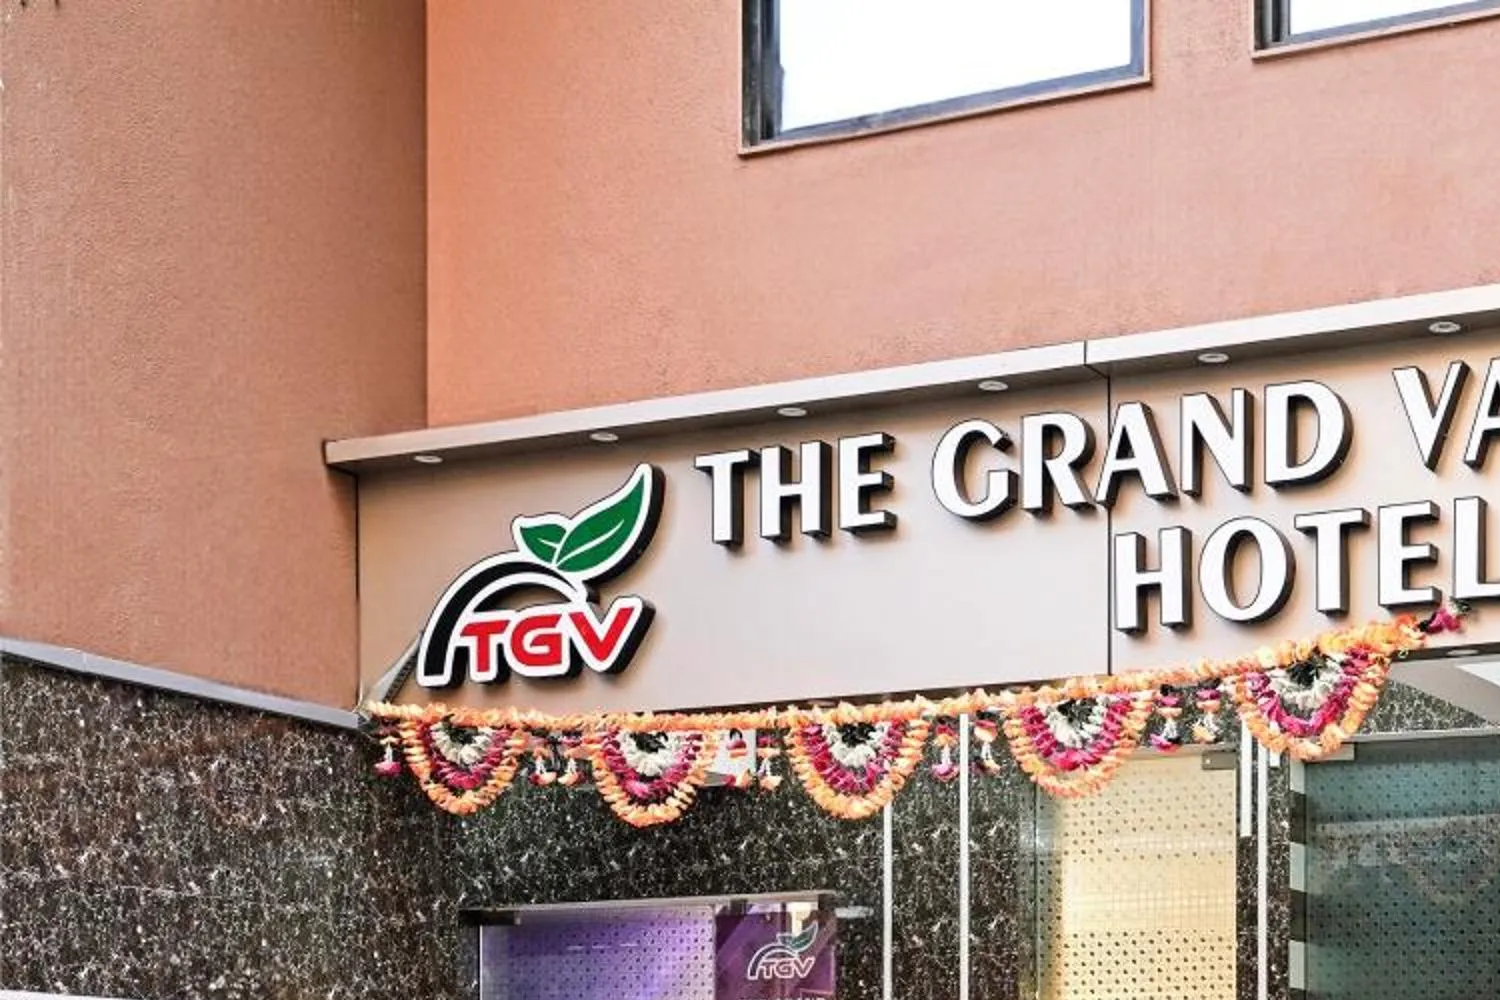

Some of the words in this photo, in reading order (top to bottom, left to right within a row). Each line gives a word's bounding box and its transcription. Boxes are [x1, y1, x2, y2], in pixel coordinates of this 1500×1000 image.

[695, 432, 896, 546] THE
[931, 380, 1352, 520] GRAND
[458, 602, 642, 678] TGV
[761, 957, 815, 979] TGV
